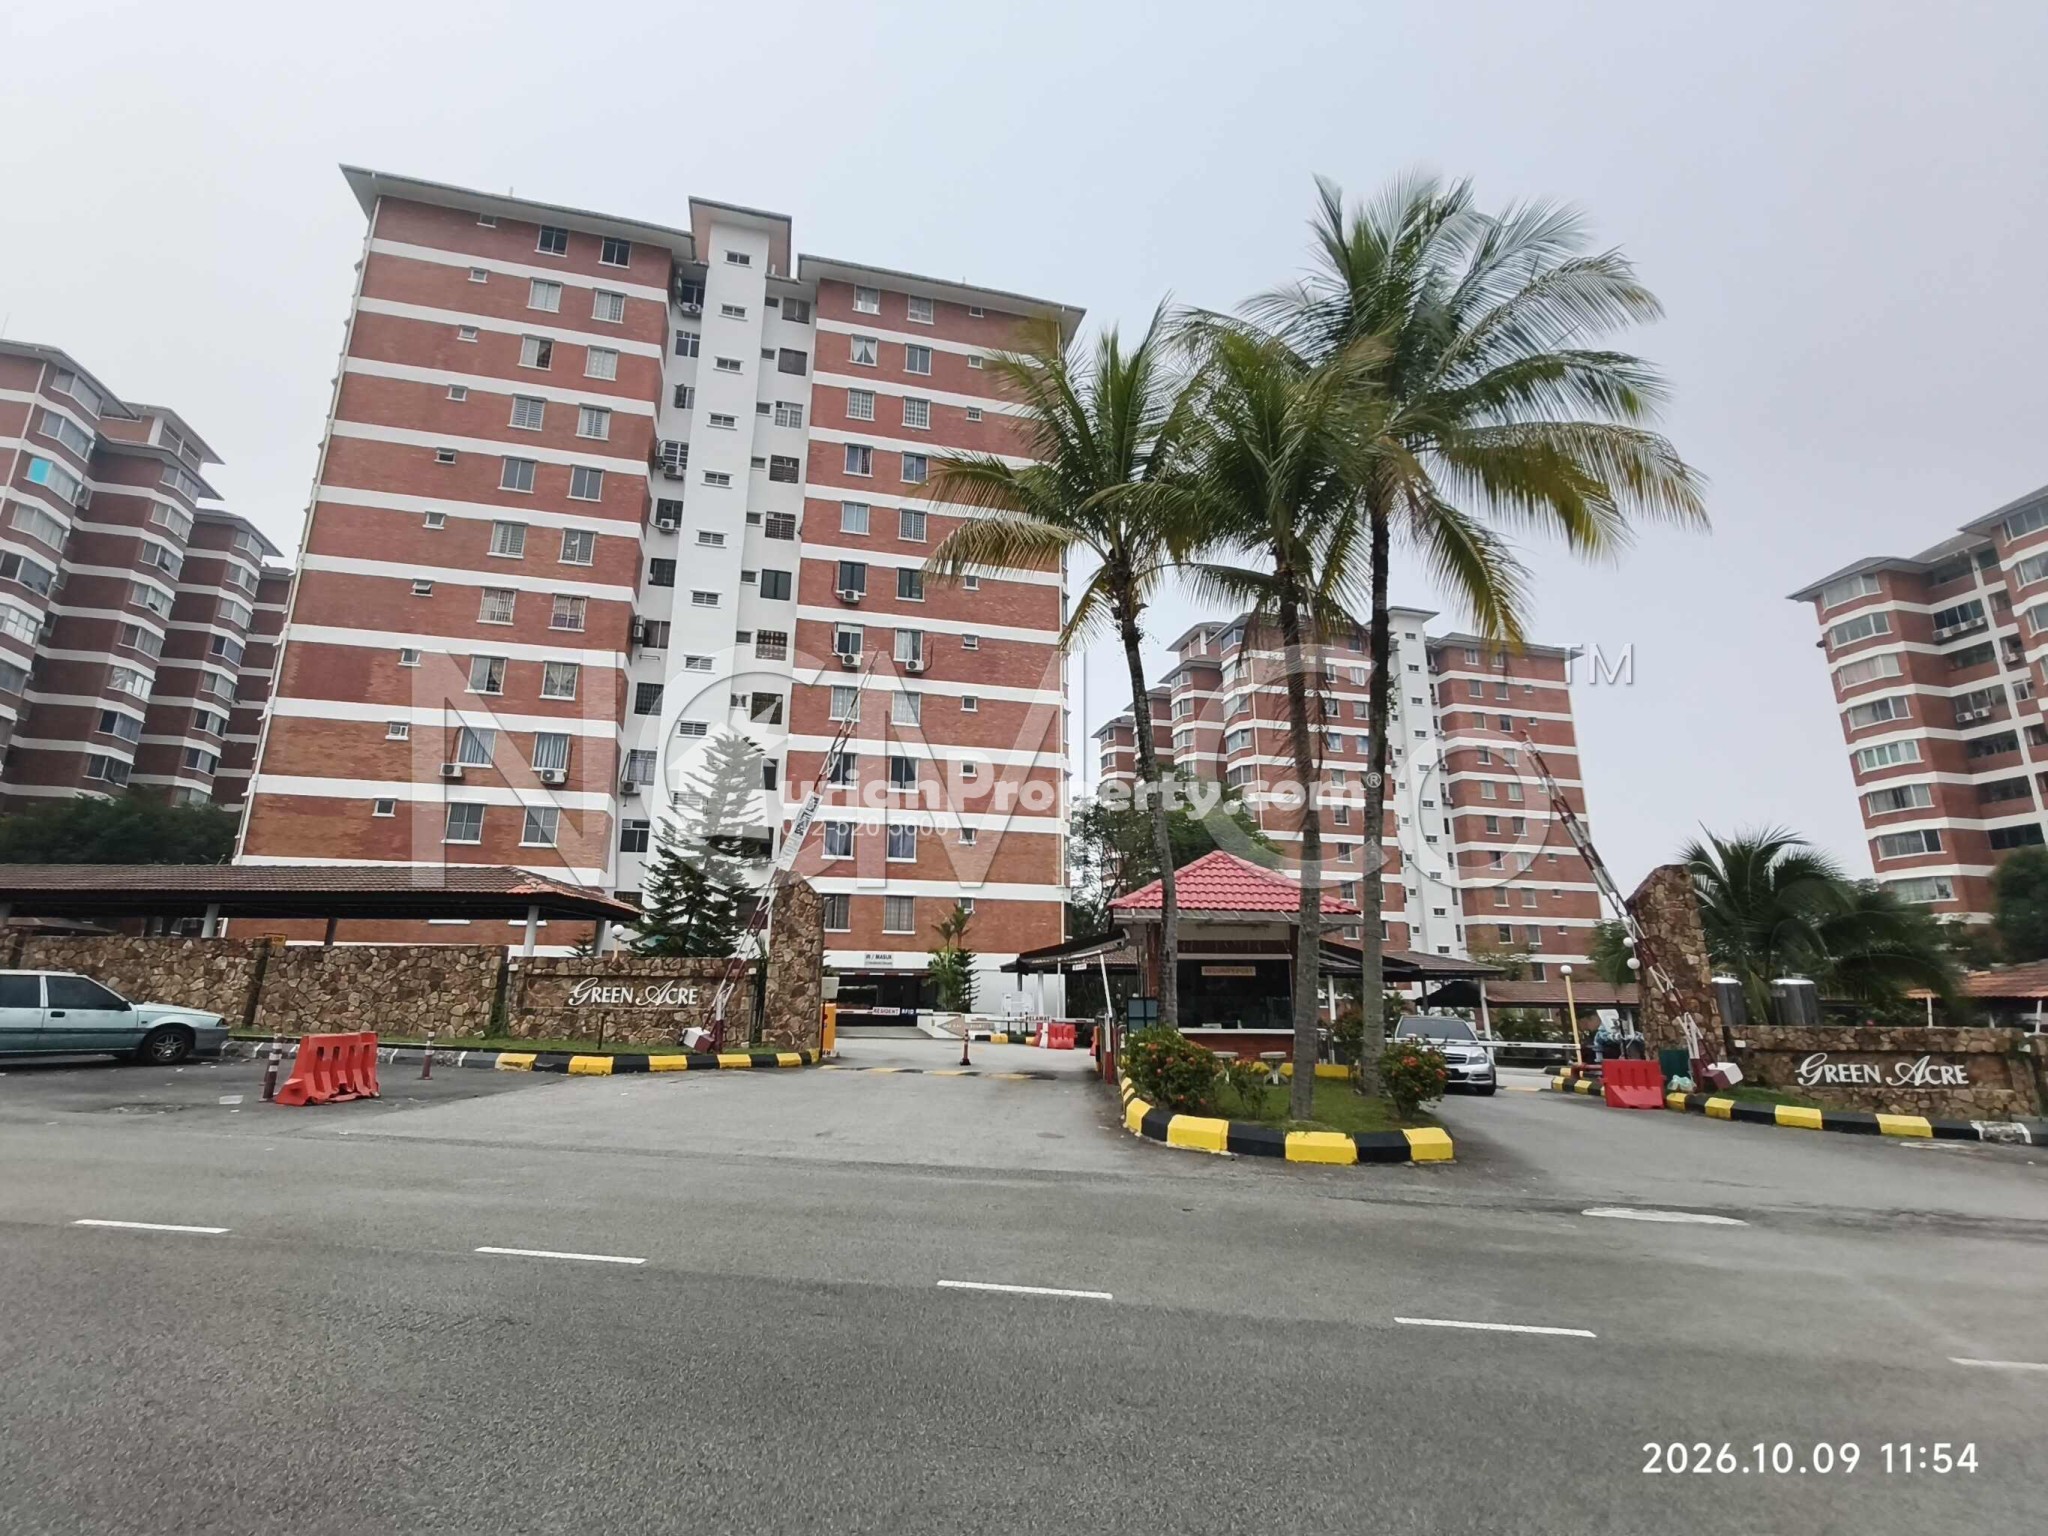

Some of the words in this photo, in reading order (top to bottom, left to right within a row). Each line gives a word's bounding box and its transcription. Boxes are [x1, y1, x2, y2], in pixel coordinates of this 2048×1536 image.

[568, 976, 634, 1006] GREEN
[635, 979, 698, 1006] ACRE
[1794, 1052, 1881, 1087] GREEN
[1885, 1055, 1970, 1087] ACRE
